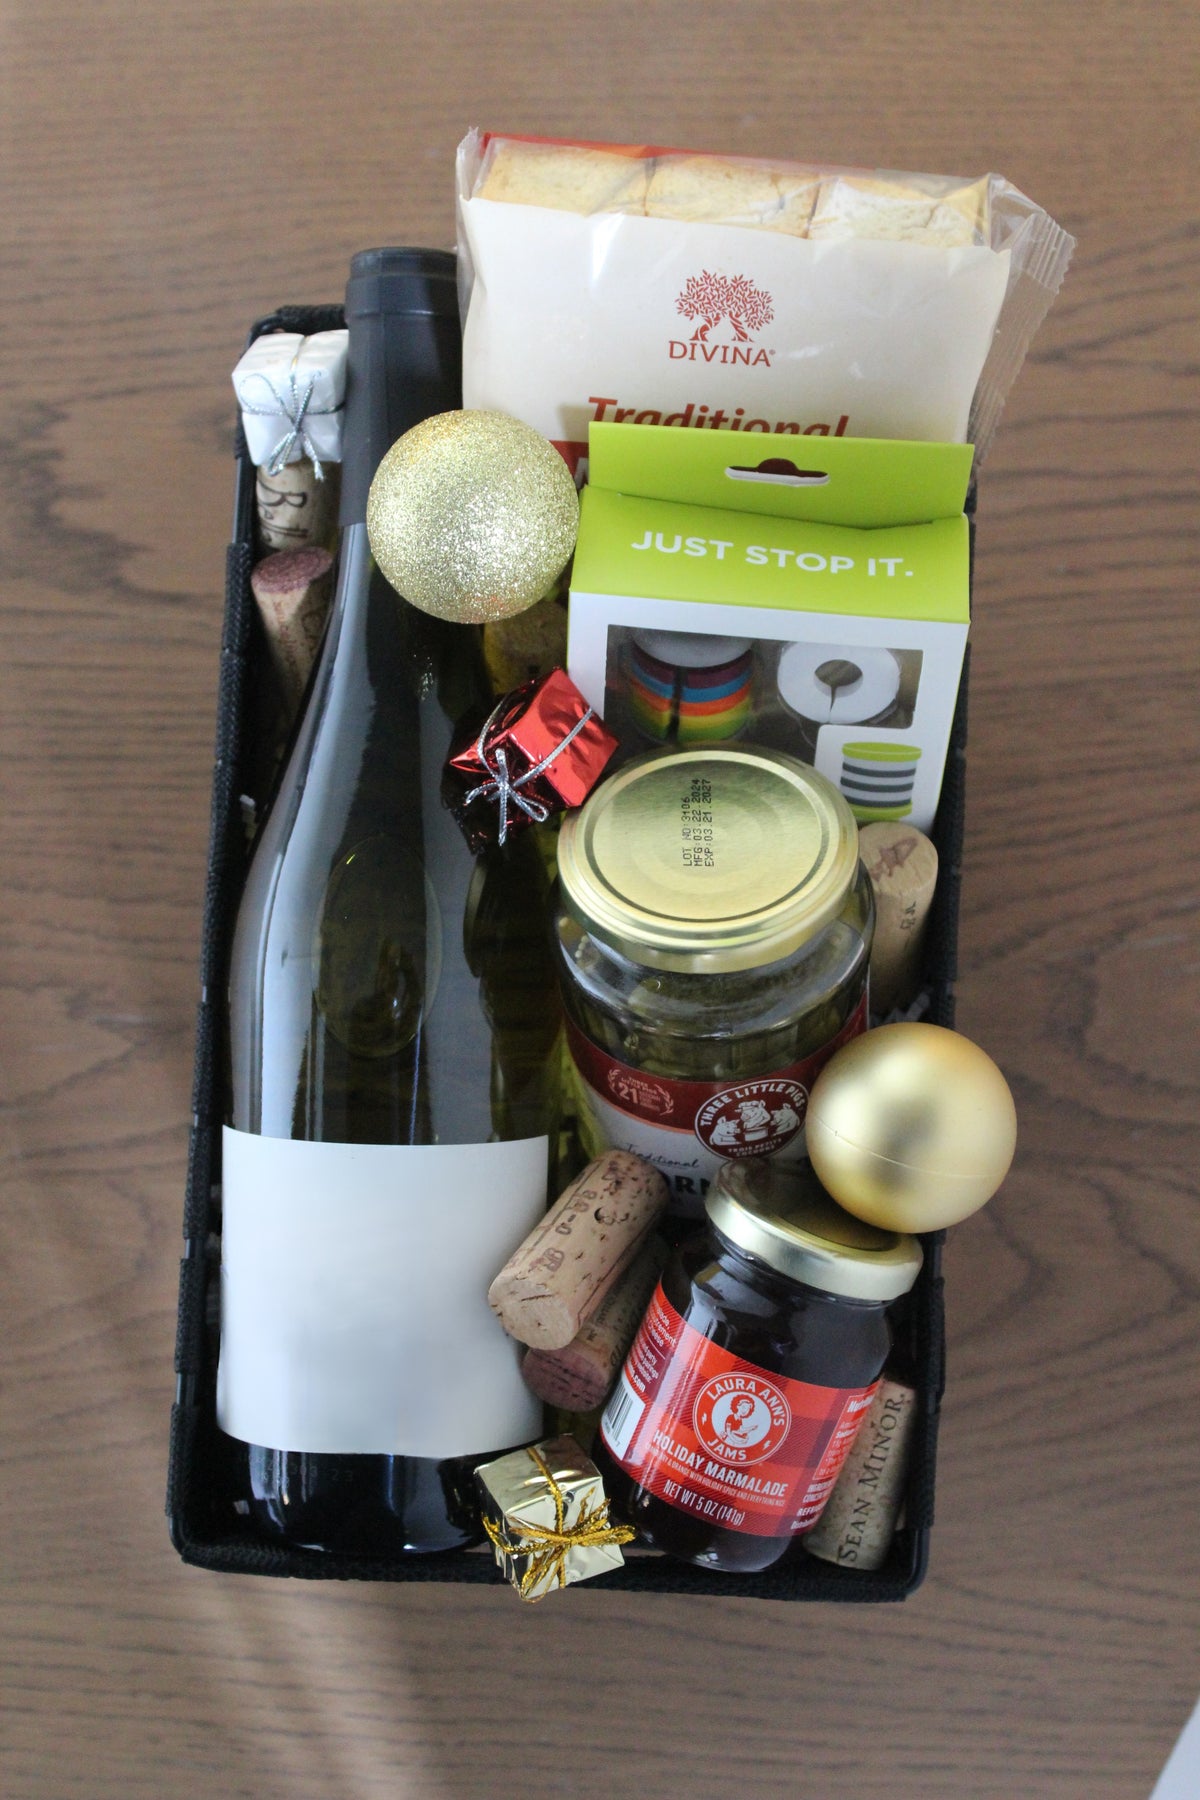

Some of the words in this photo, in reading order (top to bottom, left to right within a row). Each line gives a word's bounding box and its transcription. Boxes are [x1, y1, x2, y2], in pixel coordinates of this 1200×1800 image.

[631, 530, 733, 560] JUST
[745, 546, 855, 575] STOP
[867, 557, 914, 577] IT.
[682, 847, 693, 867] LOT
[618, 1082, 639, 1104] 21
[700, 1094, 732, 1127] THREE
[735, 1082, 786, 1099] LITTLE
[785, 1085, 806, 1108] PIGS
[707, 1378, 757, 1401] LAURA
[759, 1388, 786, 1427] ANN'S
[653, 1429, 706, 1470] HOLIDAY
[704, 1459, 789, 1498] MARMALADE
[707, 1438, 748, 1461] JAMS
[663, 1479, 682, 1500] NET
[681, 1488, 698, 1508] WT
[696, 1496, 705, 1511] 5
[703, 1499, 719, 1517] OZ
[716, 1505, 746, 1527] (141g)
[838, 1497, 872, 1562] SEAN
